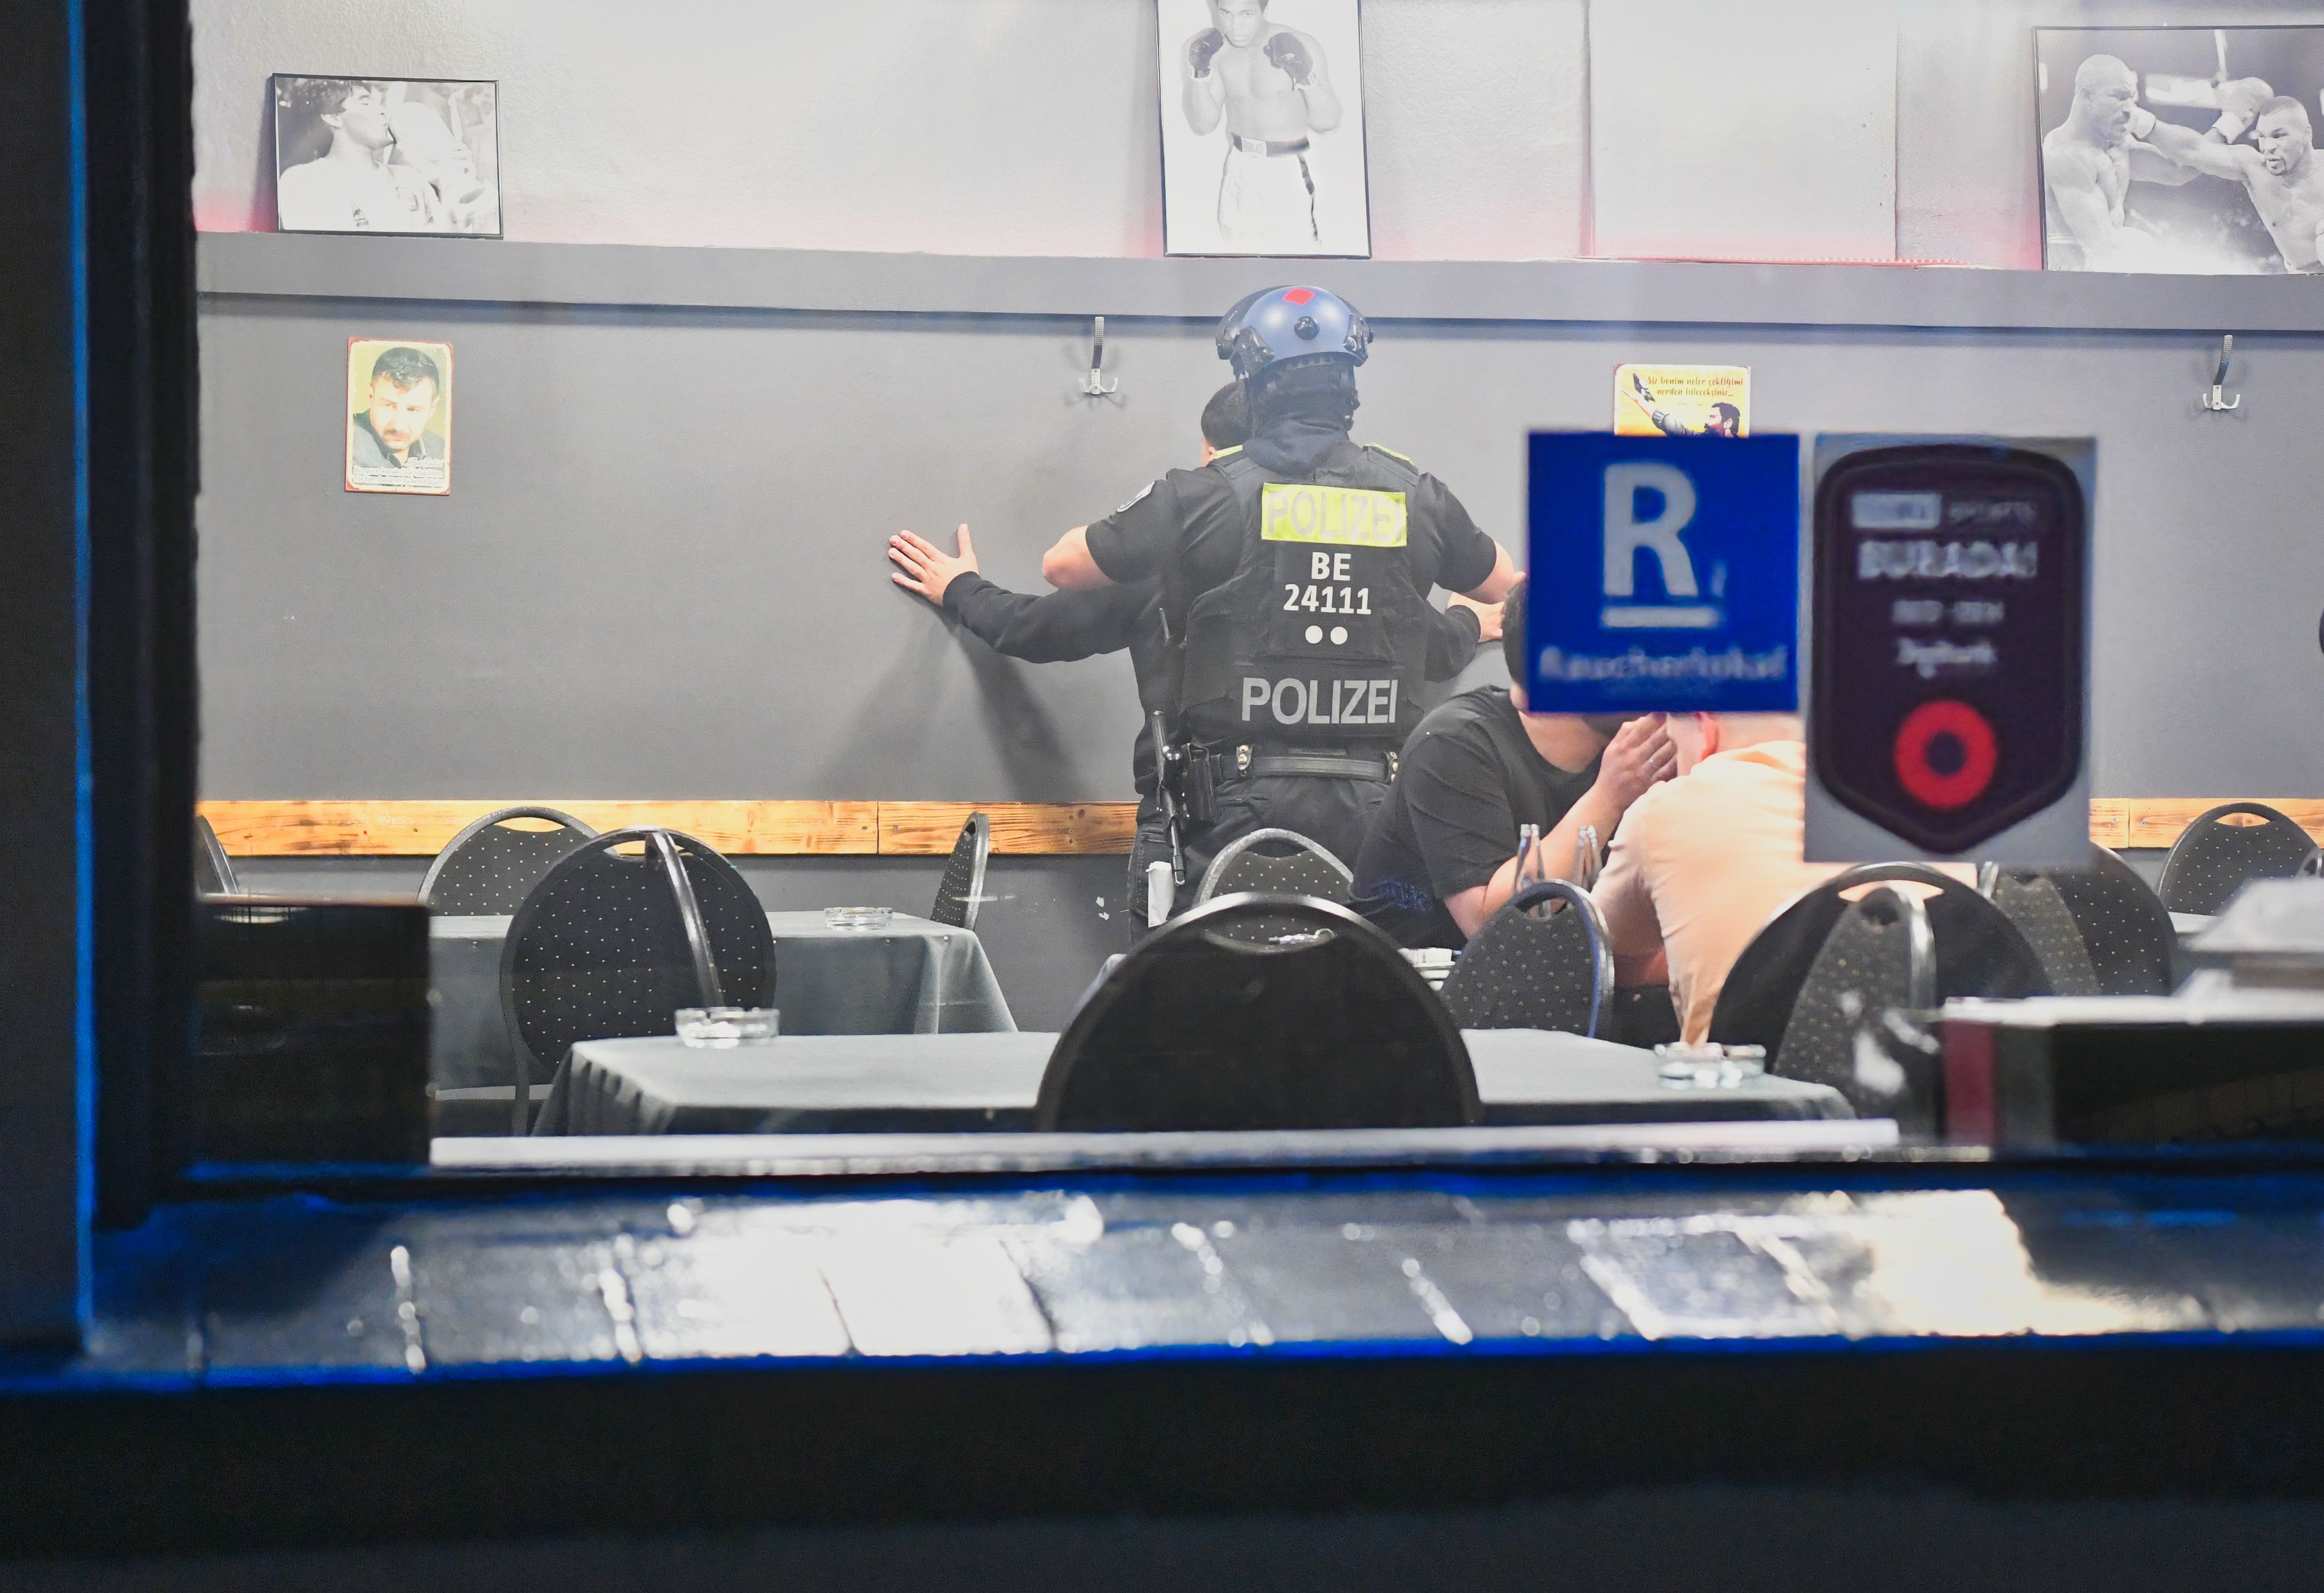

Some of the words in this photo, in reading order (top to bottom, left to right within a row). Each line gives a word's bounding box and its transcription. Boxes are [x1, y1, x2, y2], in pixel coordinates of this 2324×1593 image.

[1648, 376, 1657, 385] Siz
[1660, 376, 1683, 385] benim
[1687, 376, 1705, 385] neler
[1657, 387, 1682, 396] nerden
[1268, 490, 1403, 542] POLIZEI
[1605, 463, 1699, 597] R
[1311, 552, 1352, 581] BE
[1283, 584, 1372, 615] 24111
[1241, 677, 1399, 725] POLIZEI
